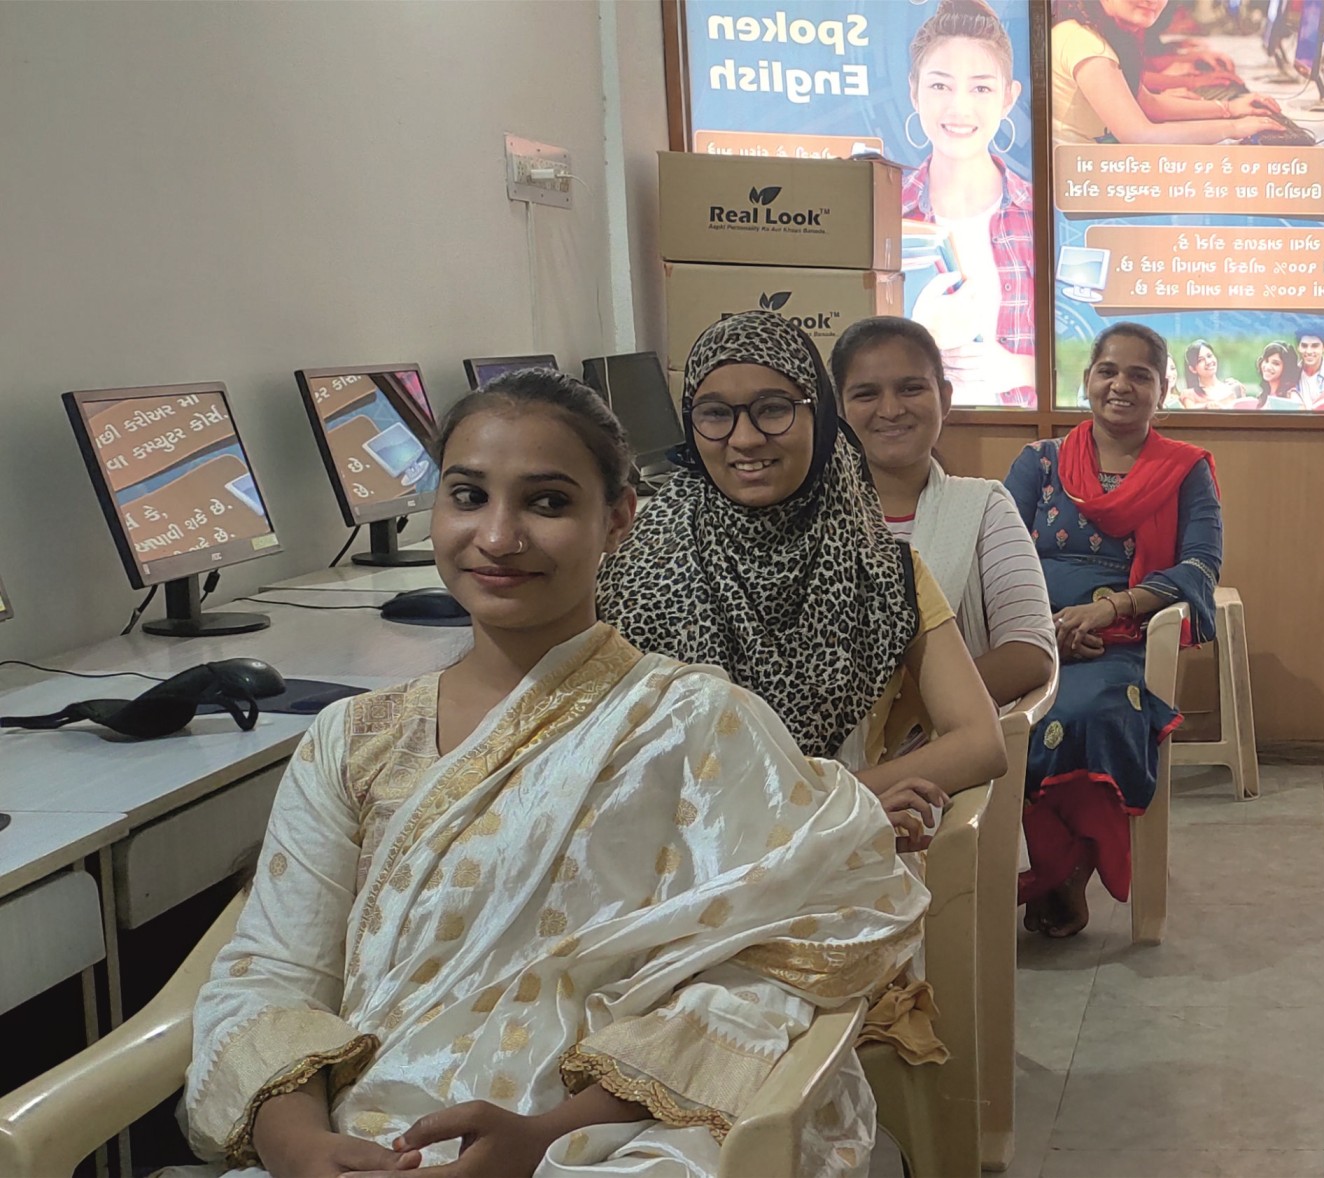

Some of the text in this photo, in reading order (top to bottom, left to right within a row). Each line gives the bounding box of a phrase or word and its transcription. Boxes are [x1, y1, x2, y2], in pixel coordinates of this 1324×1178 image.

[709, 206, 758, 224] Real
[766, 207, 821, 226] Look
[784, 313, 831, 329] ook
[124, 404, 176, 432] કરીઅર
[189, 405, 229, 432] કોર્સ.
[184, 509, 208, 530] શકે
[210, 498, 233, 516] છે.
[214, 527, 236, 543] છે.
